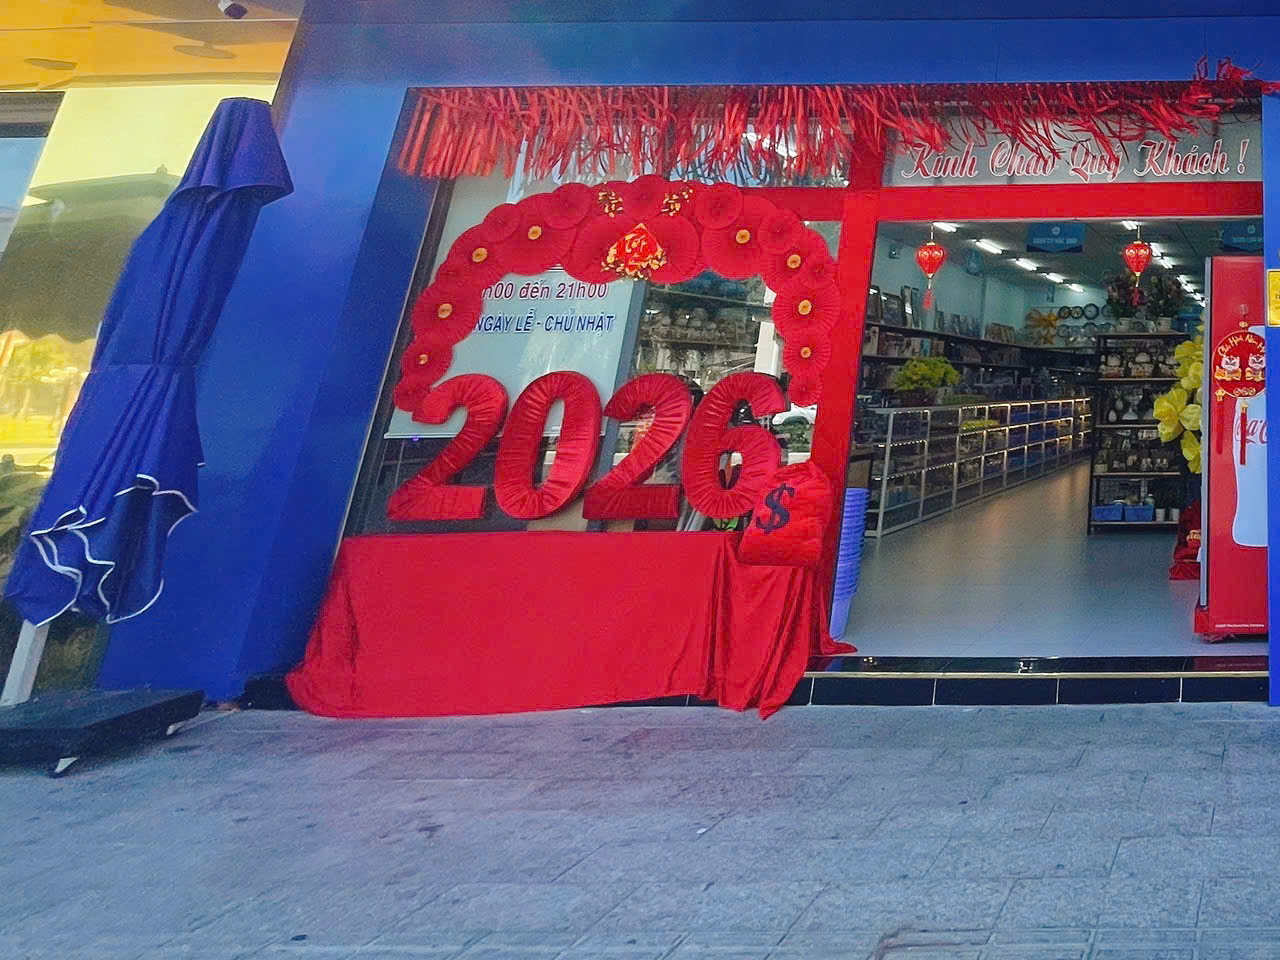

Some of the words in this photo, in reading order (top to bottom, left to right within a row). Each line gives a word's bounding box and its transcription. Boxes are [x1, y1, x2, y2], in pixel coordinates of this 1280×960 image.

[1133, 138, 1230, 177] Khách
[518, 279, 550, 299] đến
[555, 282, 608, 299] 21h00
[515, 308, 536, 332] LỄ
[544, 307, 576, 332] CHỦ
[576, 311, 615, 336] NHẬT
[387, 370, 791, 520] 2026
